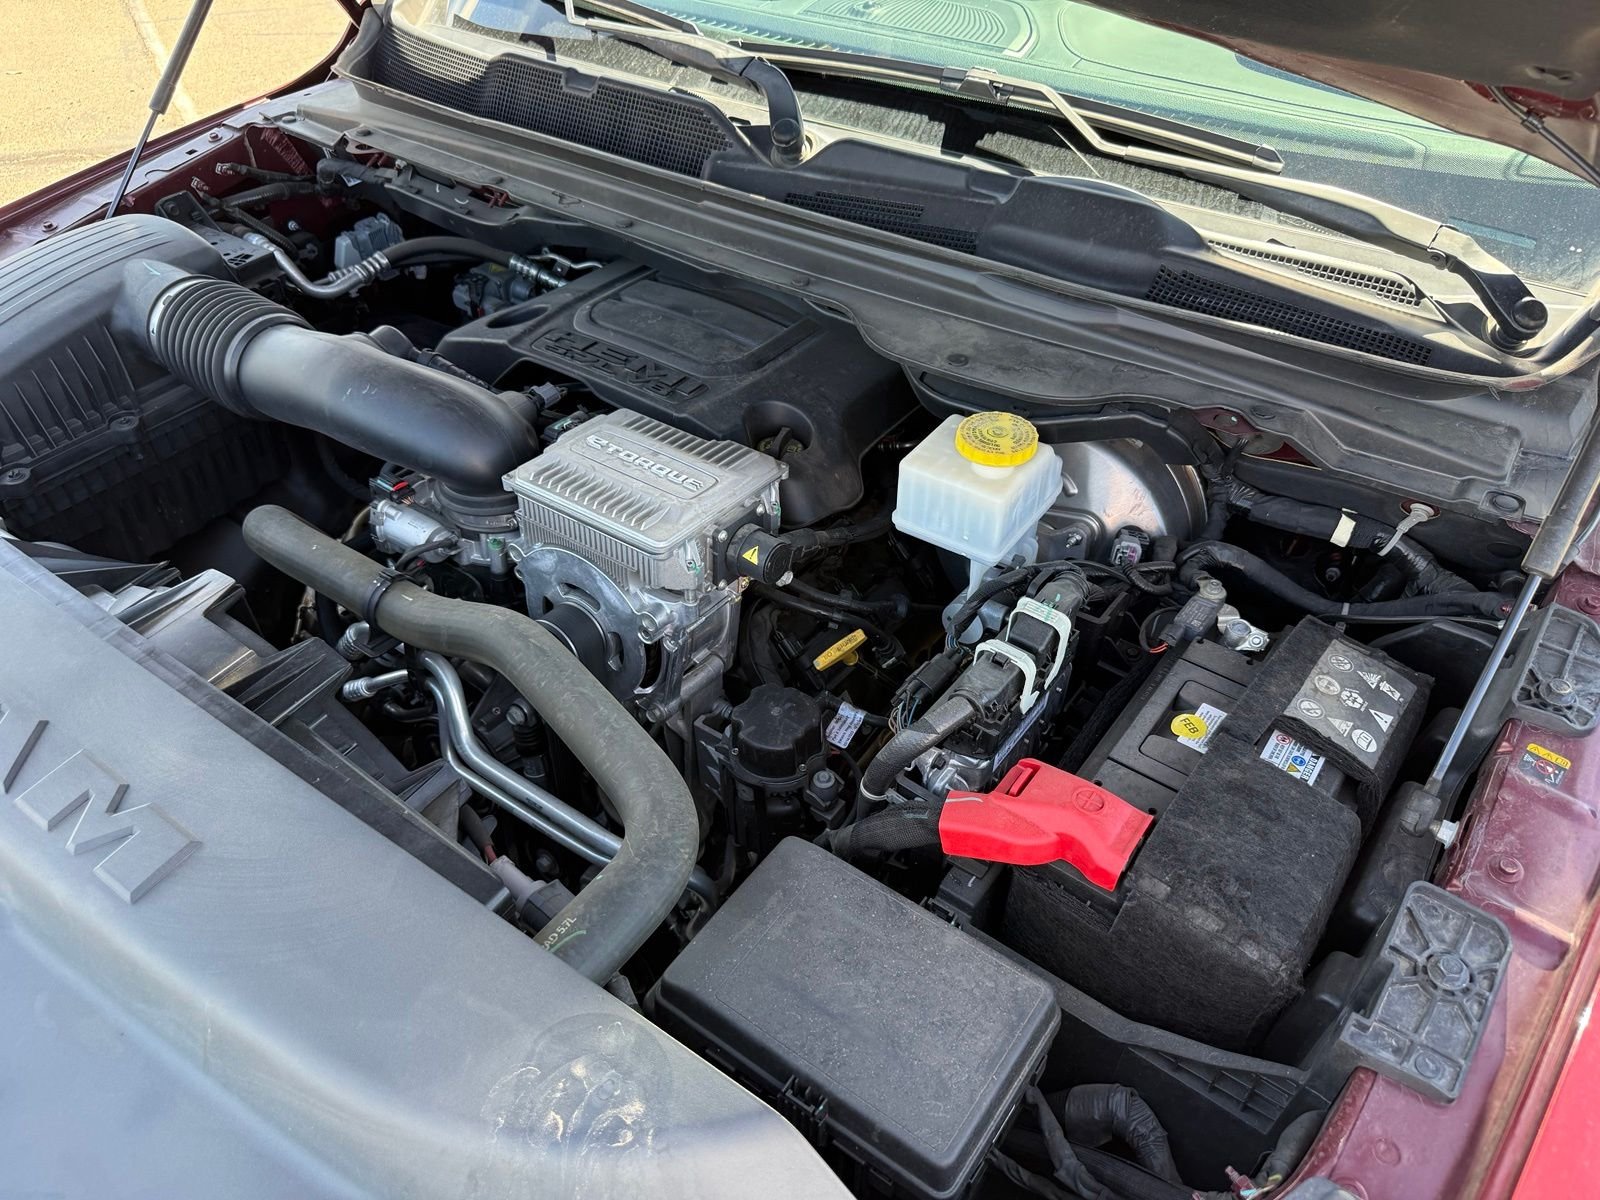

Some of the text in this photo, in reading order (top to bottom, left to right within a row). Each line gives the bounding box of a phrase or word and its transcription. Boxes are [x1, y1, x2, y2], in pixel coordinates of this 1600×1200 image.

[544, 330, 711, 400] HEMI
[1180, 717, 1199, 734] FEB
[1301, 757, 1318, 781] DANGER
[555, 916, 576, 934] 5.7L
